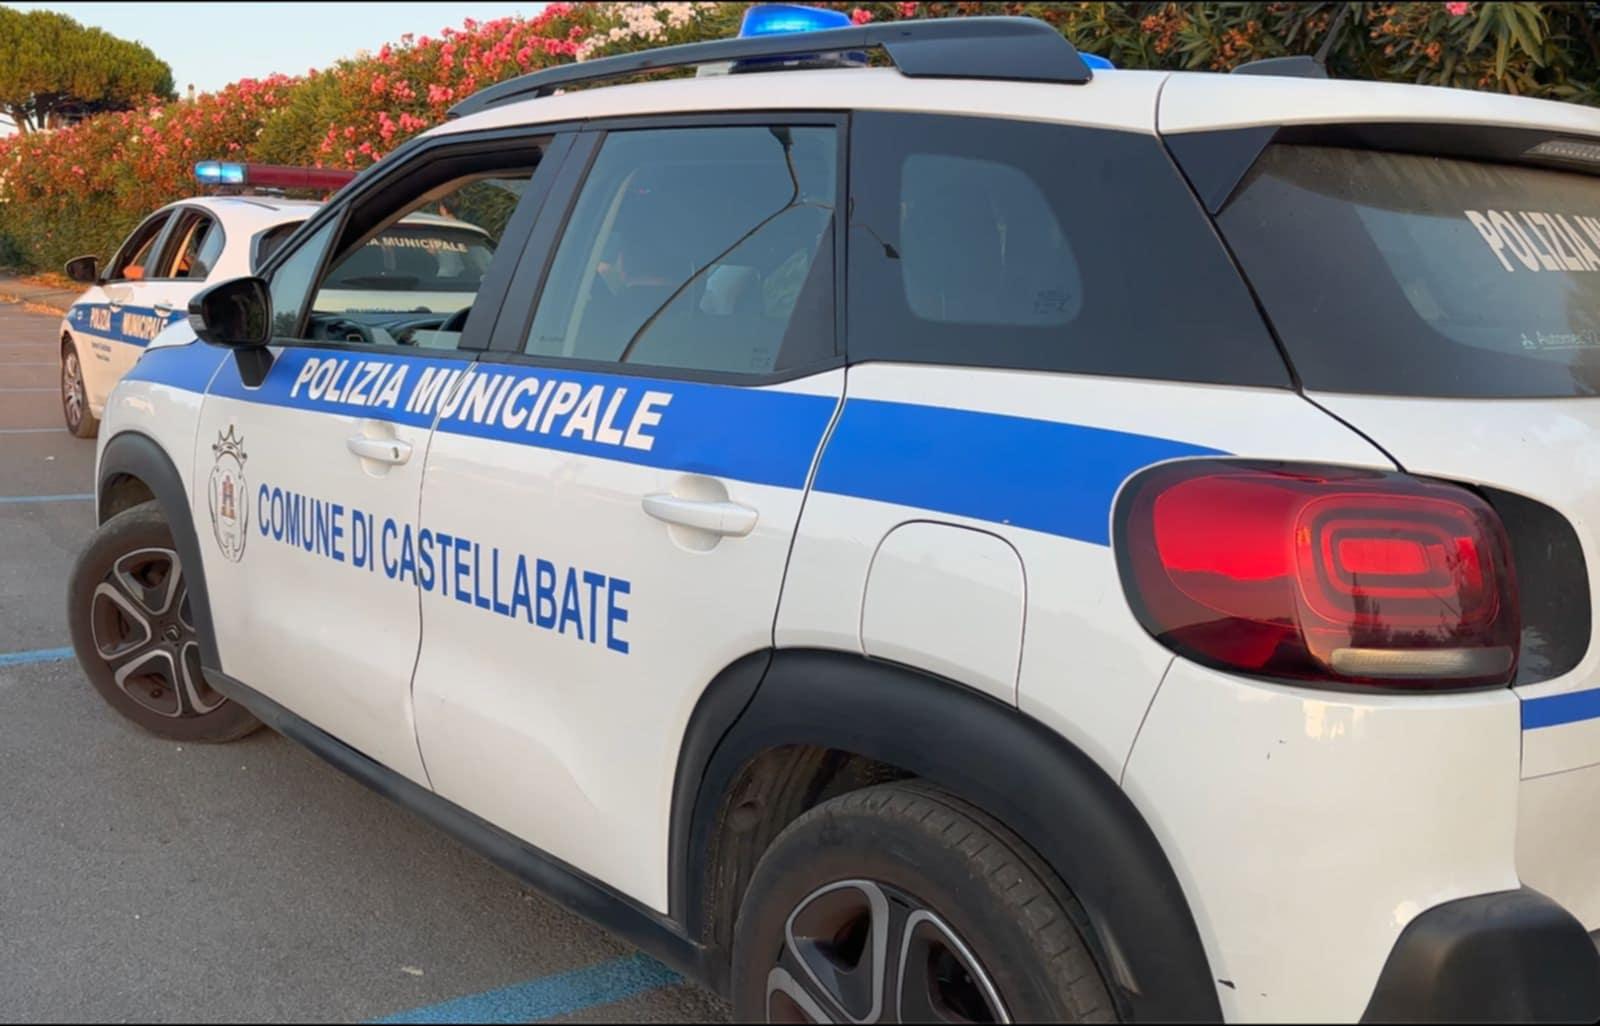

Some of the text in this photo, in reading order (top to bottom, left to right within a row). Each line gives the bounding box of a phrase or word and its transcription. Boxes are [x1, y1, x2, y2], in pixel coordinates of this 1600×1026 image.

[382, 237, 467, 252] MUNICIPALE
[1464, 209, 1600, 272] POLIZIA
[291, 358, 673, 451] POLIZIA MUNICIPALE
[258, 483, 632, 655] COMUNE DI CASTELLABATE
